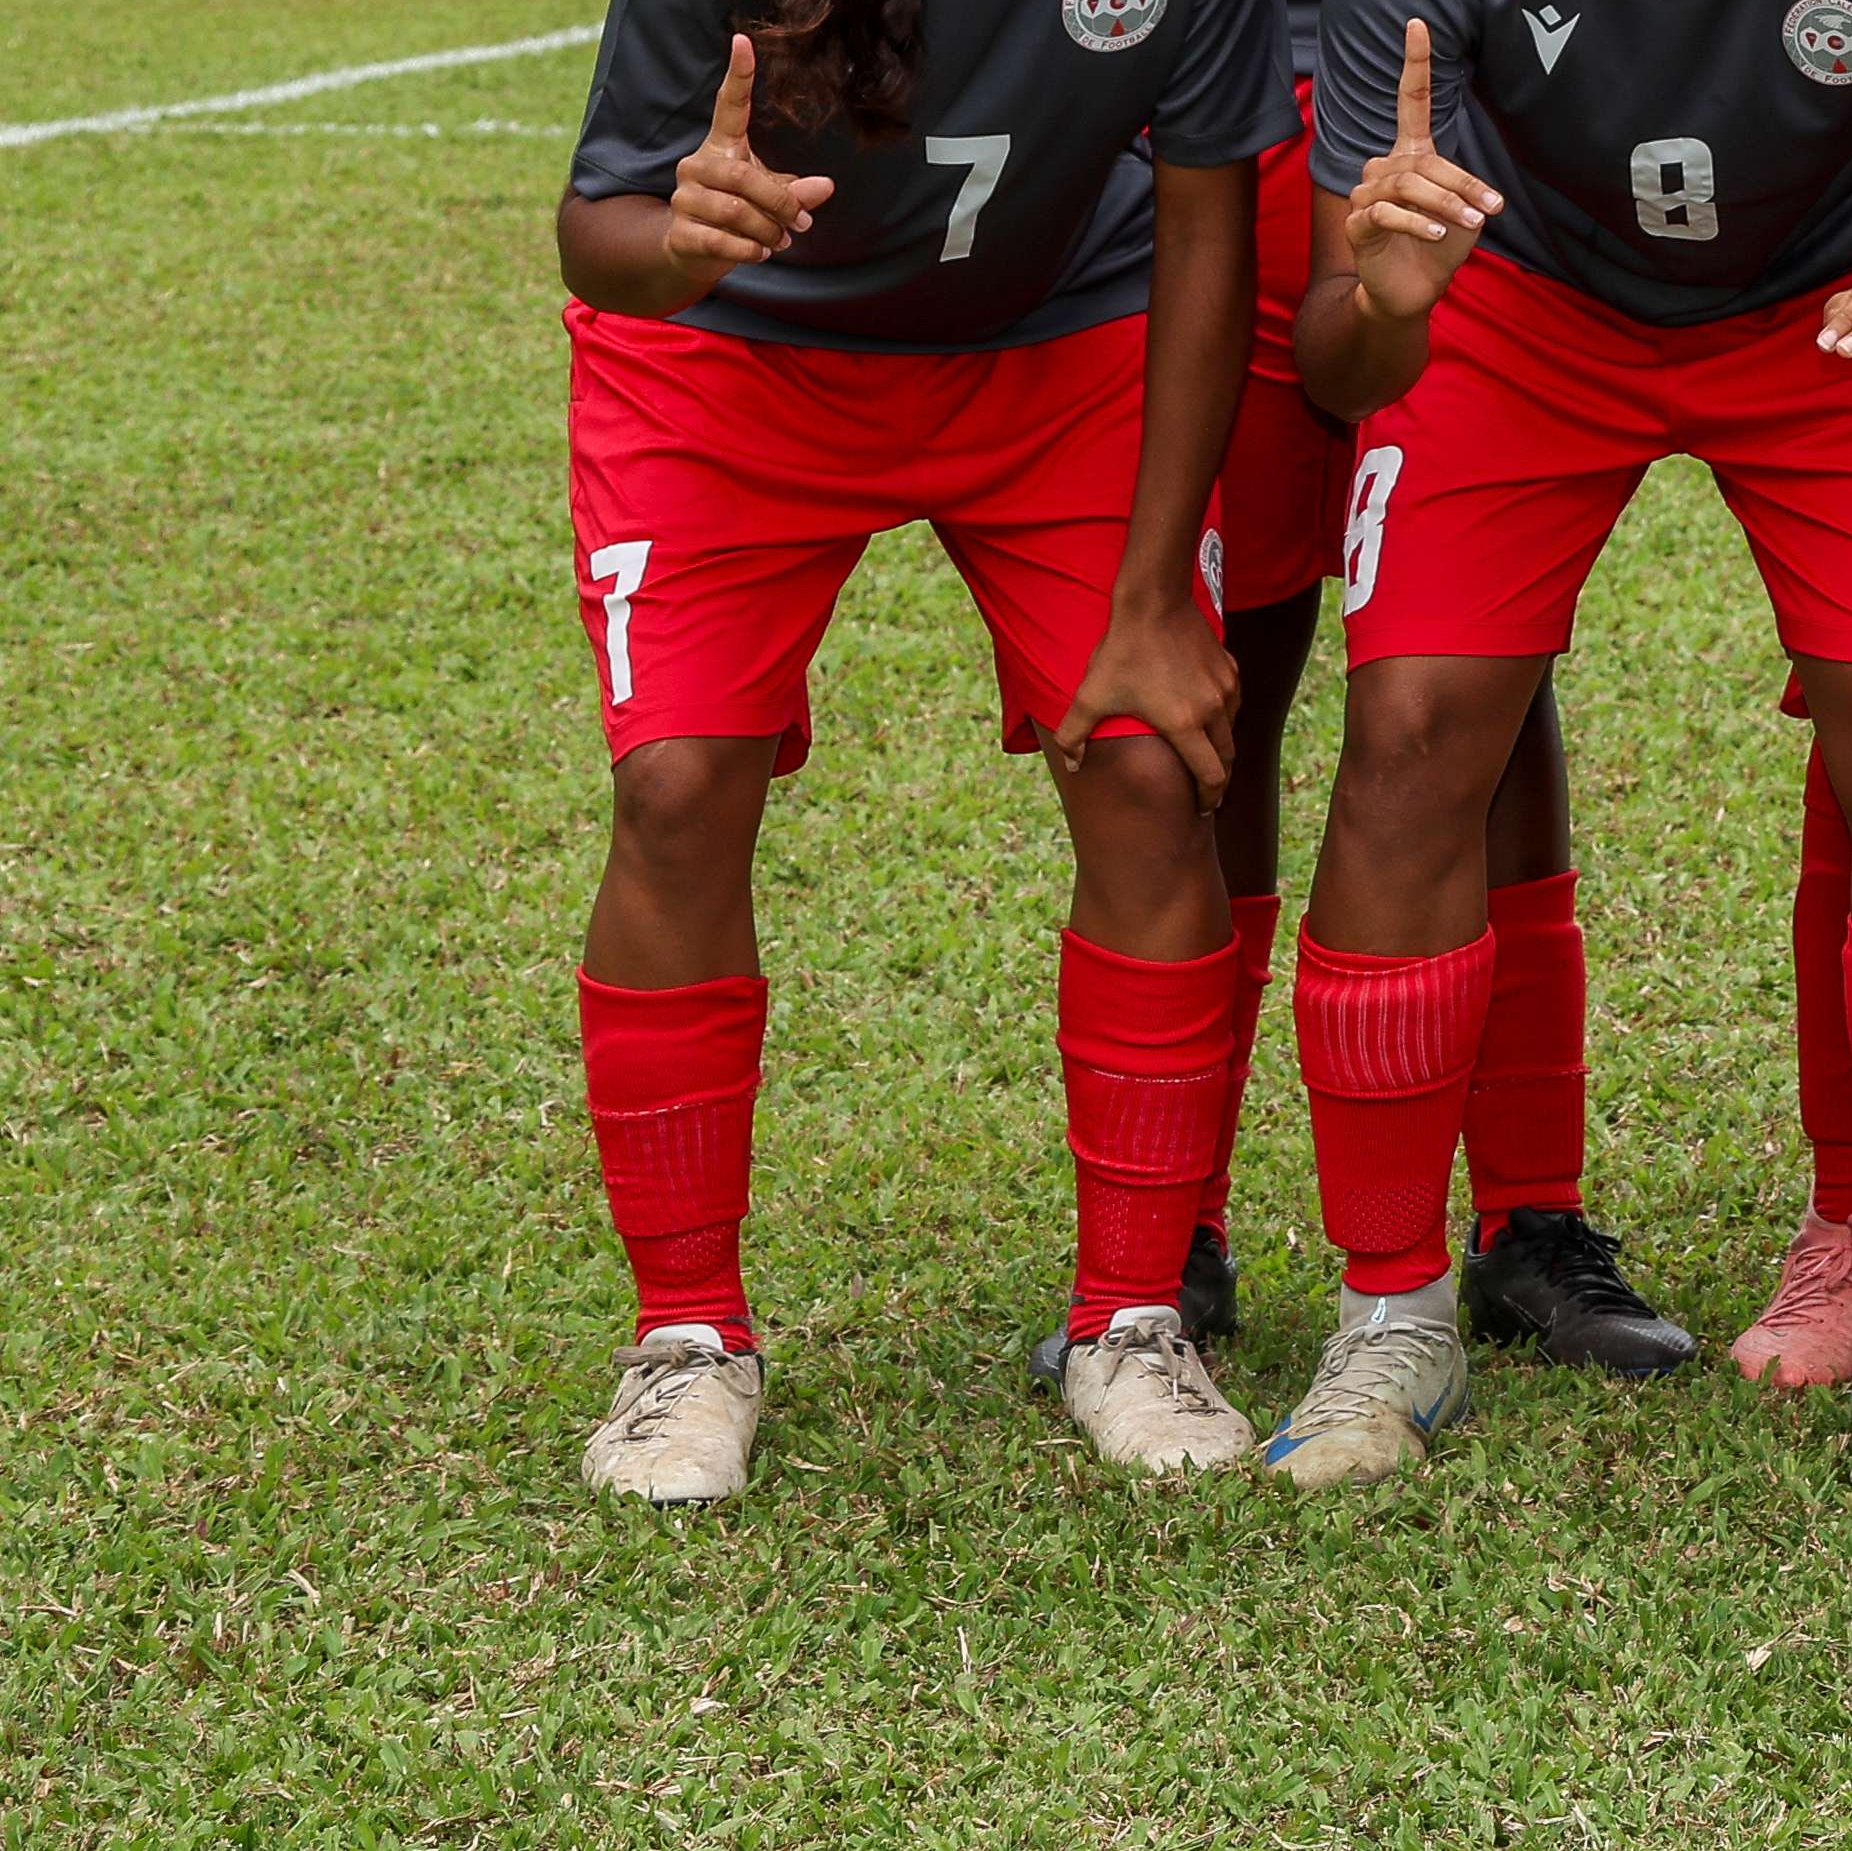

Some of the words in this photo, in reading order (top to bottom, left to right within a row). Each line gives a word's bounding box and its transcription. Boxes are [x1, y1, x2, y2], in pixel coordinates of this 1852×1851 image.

[924, 133, 1012, 264] 7
[1629, 137, 1719, 241] 8
[1343, 445, 1405, 617] 8
[589, 540, 653, 707] 7
